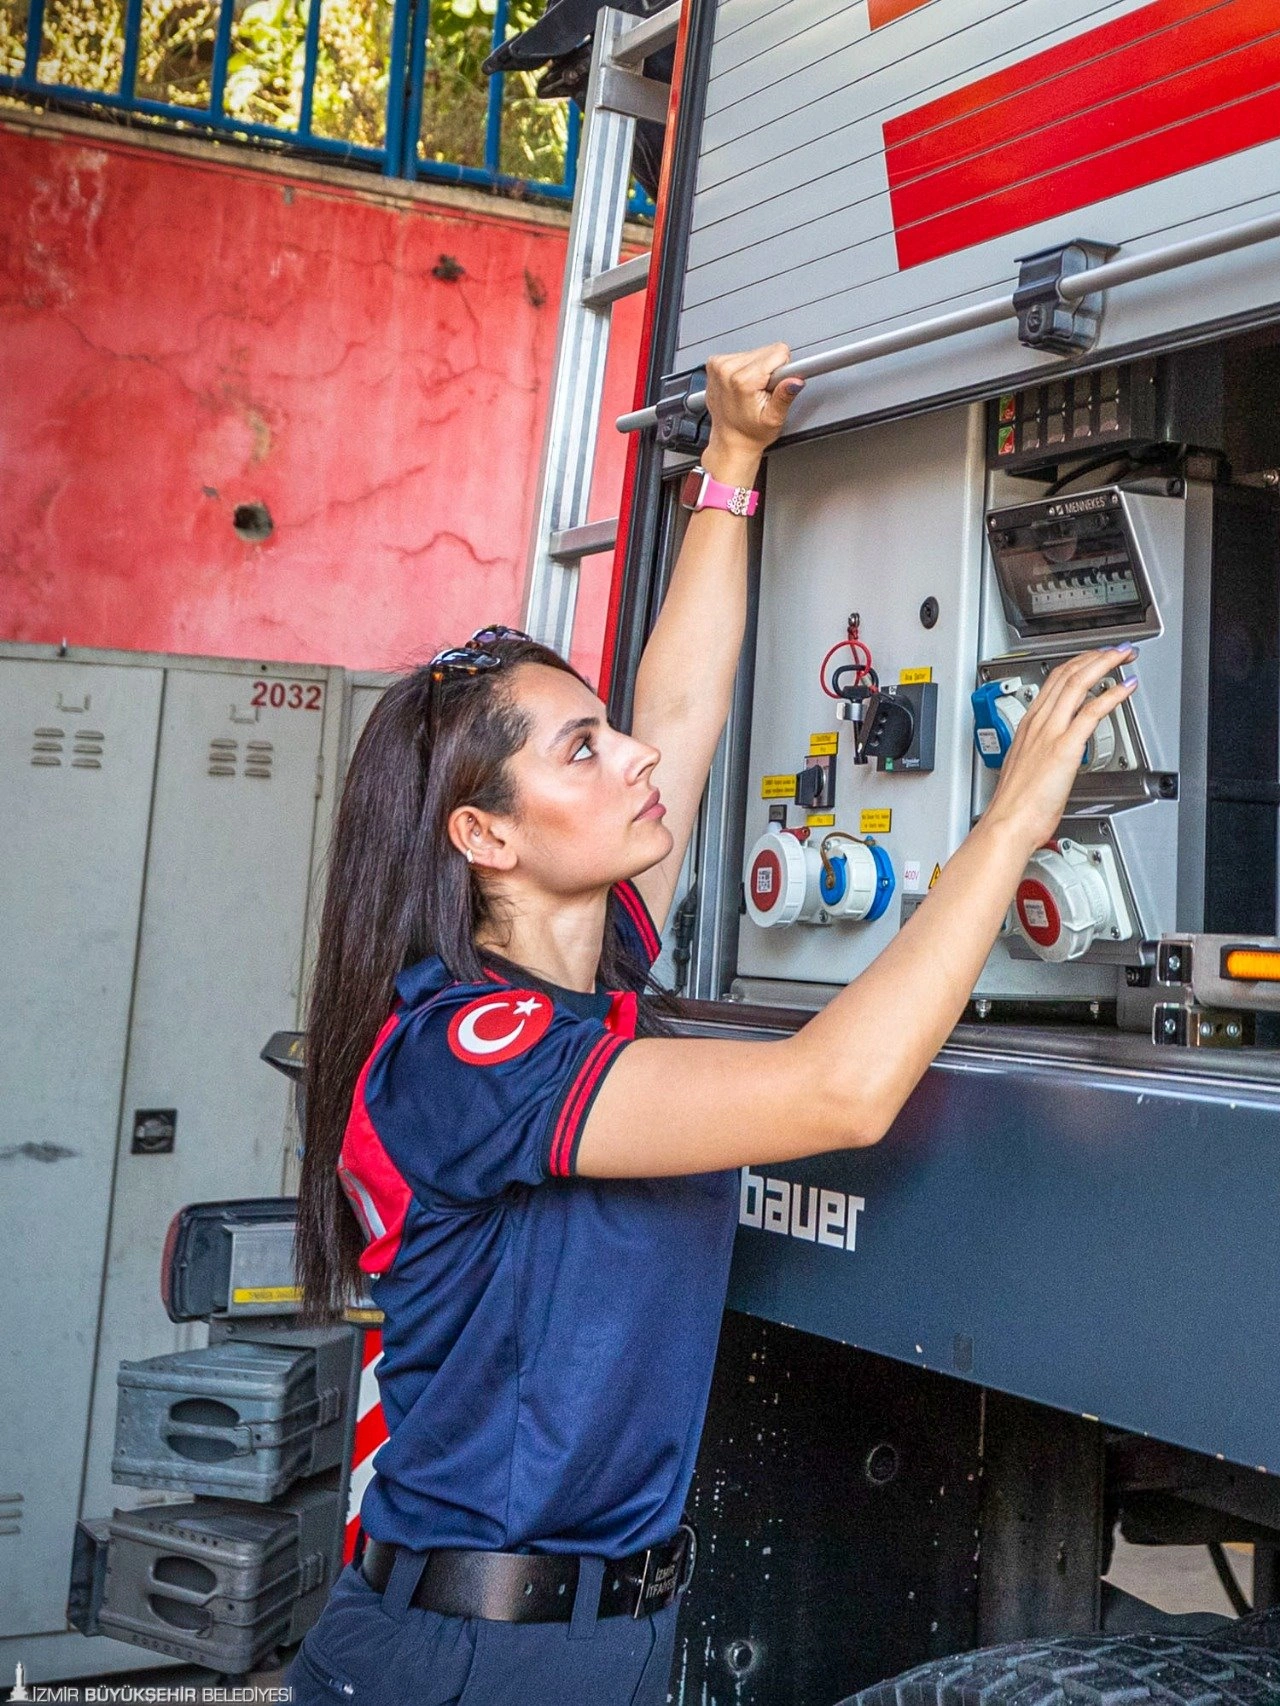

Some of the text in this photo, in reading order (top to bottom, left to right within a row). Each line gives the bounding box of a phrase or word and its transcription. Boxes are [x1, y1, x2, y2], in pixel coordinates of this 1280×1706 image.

[1065, 496, 1105, 513] MENNEKES
[251, 682, 321, 710] 2032
[904, 870, 920, 881] 400V
[739, 1165, 865, 1252] bauer
